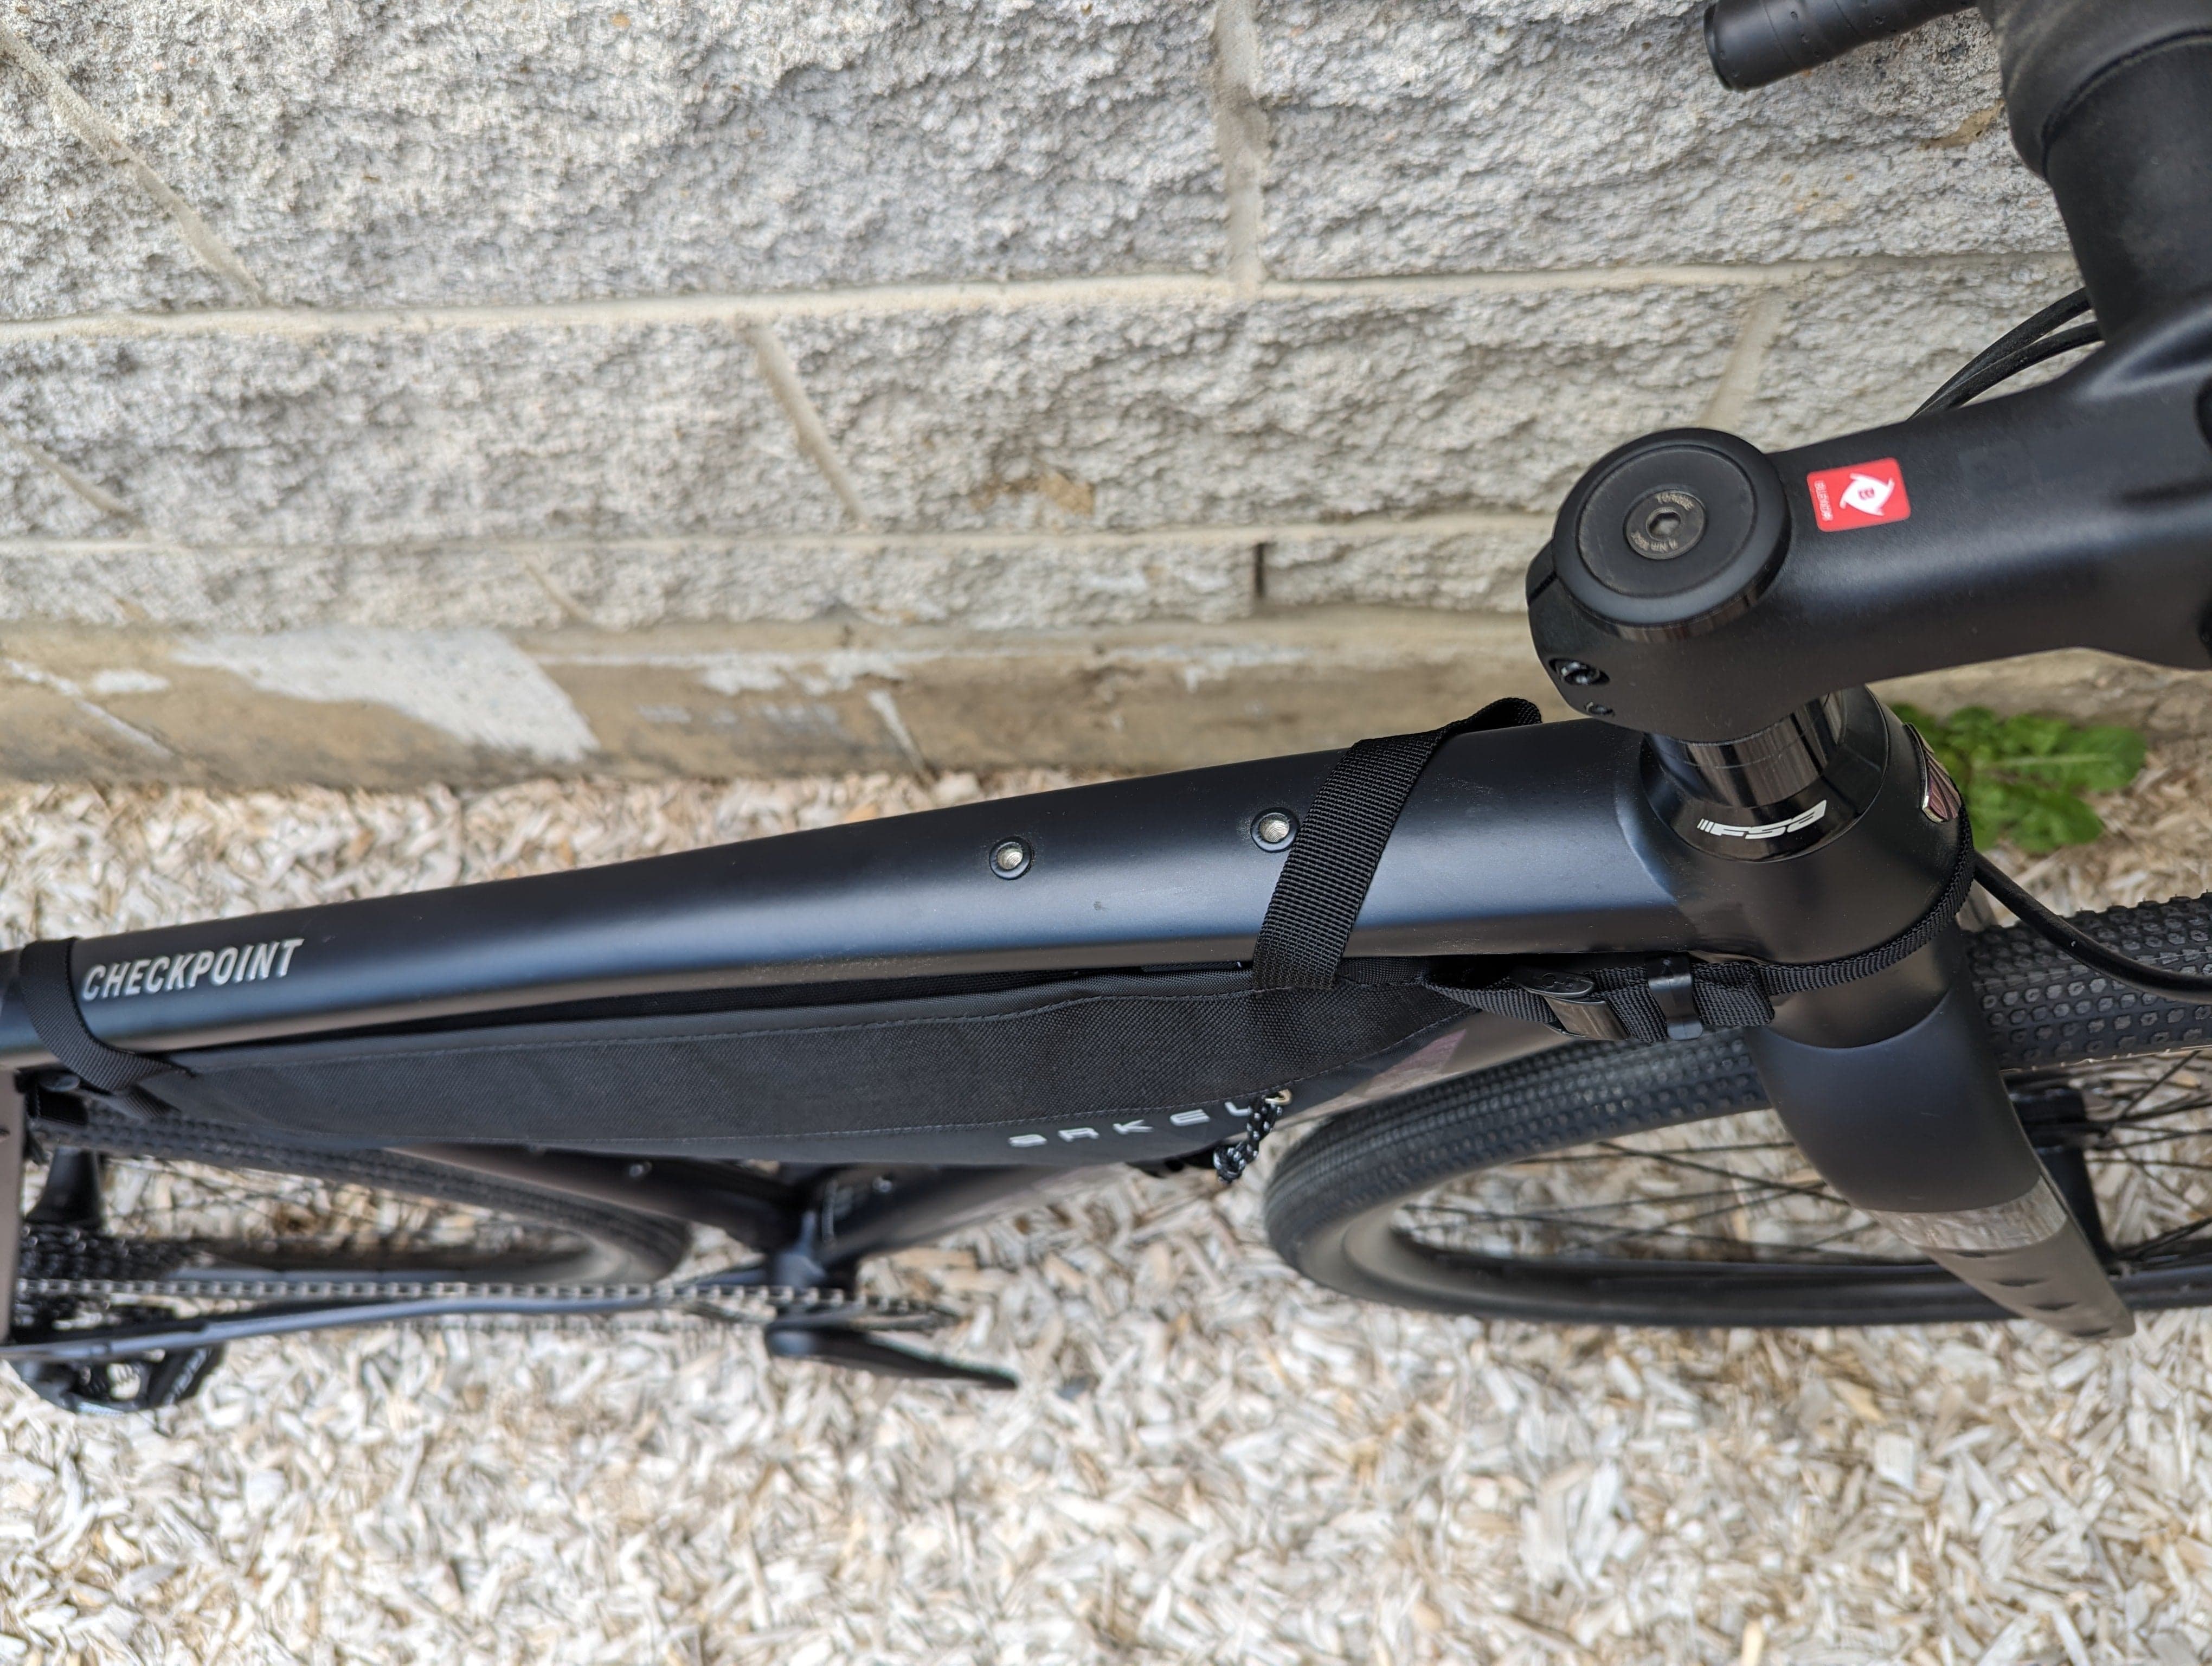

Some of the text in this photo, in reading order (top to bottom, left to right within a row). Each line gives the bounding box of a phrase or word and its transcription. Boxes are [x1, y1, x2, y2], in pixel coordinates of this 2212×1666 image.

[1708, 799, 1827, 840] FSA
[81, 938, 305, 1002] CHECKPOINT
[1008, 1101, 1251, 1148] ARKEL
